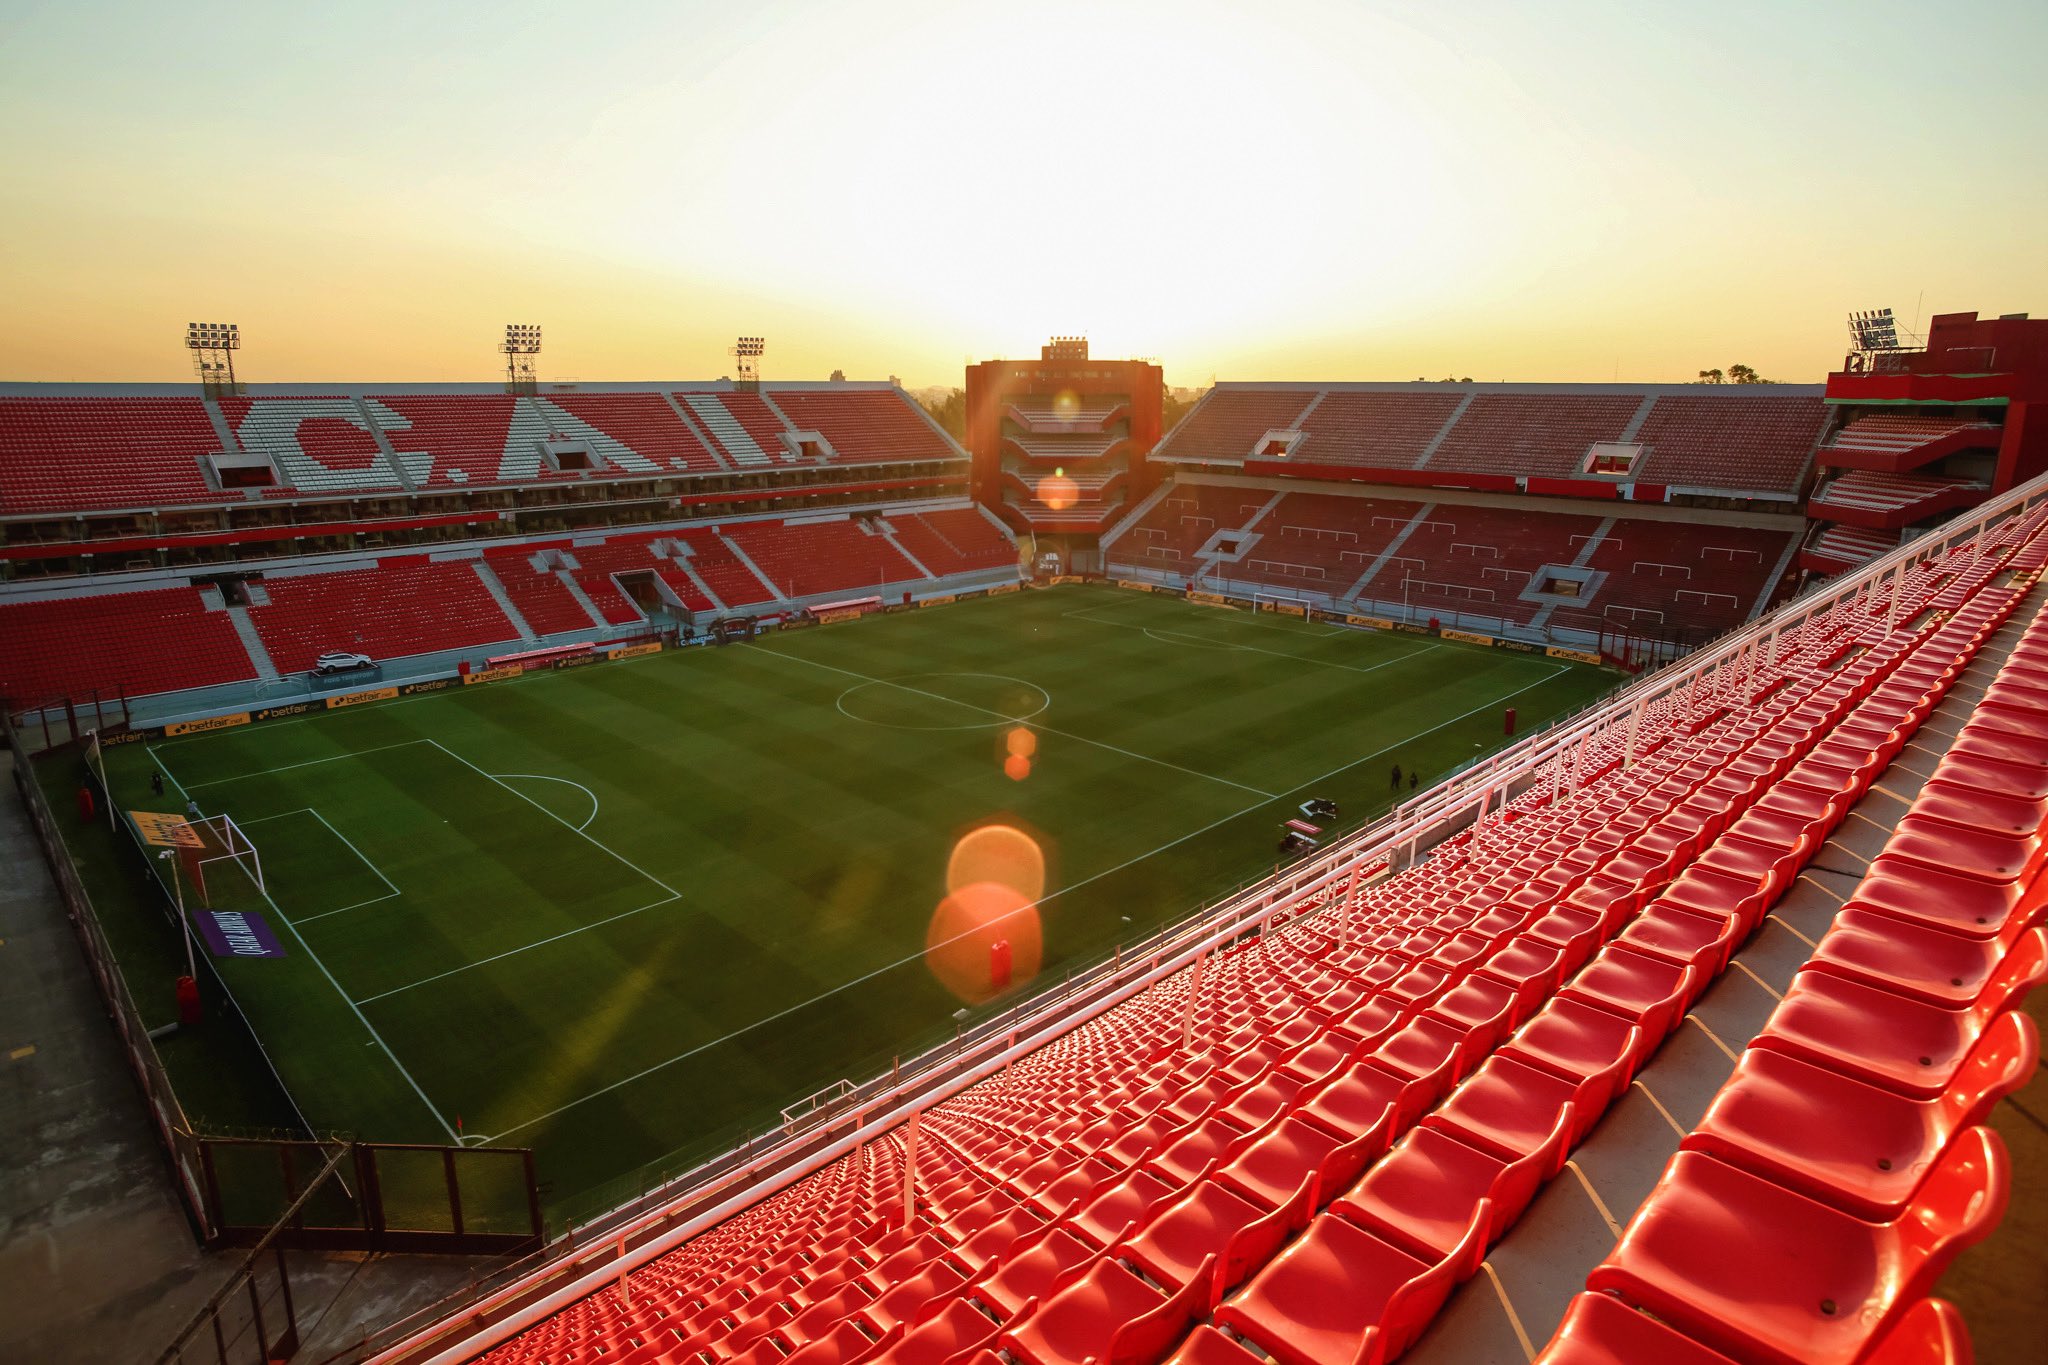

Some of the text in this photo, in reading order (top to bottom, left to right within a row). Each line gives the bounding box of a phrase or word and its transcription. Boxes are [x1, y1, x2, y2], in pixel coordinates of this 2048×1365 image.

[188, 717, 244, 732] betfair.net
[210, 911, 272, 955] QATAR AIRWAYS
